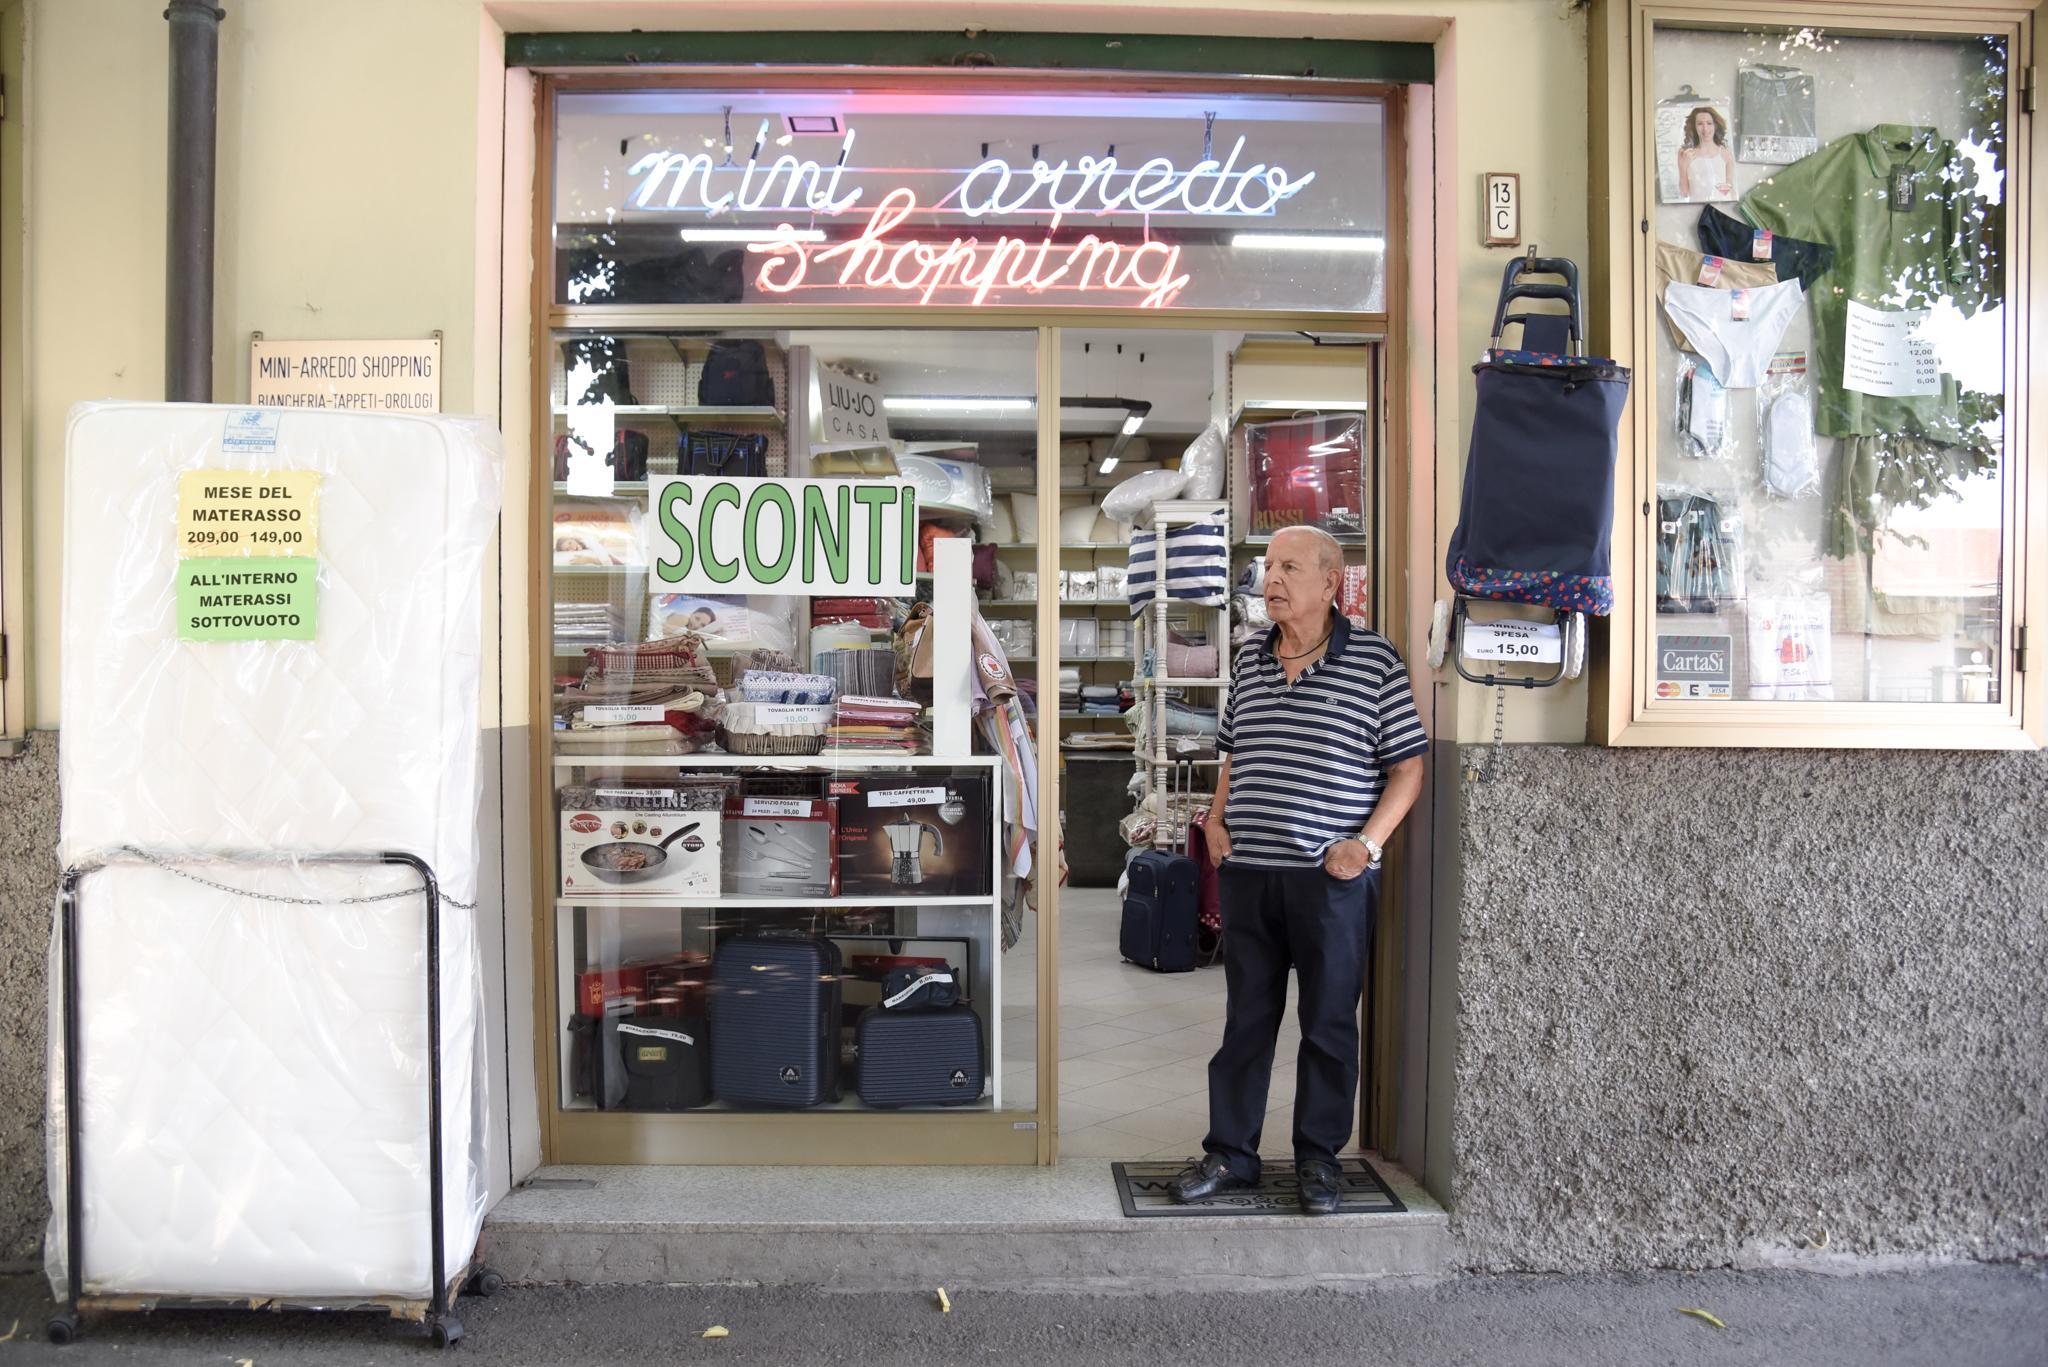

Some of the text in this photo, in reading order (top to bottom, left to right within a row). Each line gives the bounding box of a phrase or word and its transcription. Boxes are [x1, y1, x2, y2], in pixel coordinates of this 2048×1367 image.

[630, 118, 1316, 218] mini arredo
[1491, 182, 1512, 204] 13
[1496, 210, 1510, 231] C
[259, 355, 433, 379] MINI-ARREDO SHOPPING
[204, 486, 292, 499] MESE DEL
[192, 508, 302, 522] MATERASSO
[187, 531, 303, 546] 209,00 149,00
[656, 481, 916, 586] SCONTI
[190, 572, 298, 587] ALL'INTERNO
[199, 593, 291, 608] MATERASSI
[190, 614, 301, 629] SOTTOVUOTO
[1493, 630, 1529, 639] SPESA
[1497, 643, 1539, 656] 15,00
[785, 715, 809, 723] 10,00
